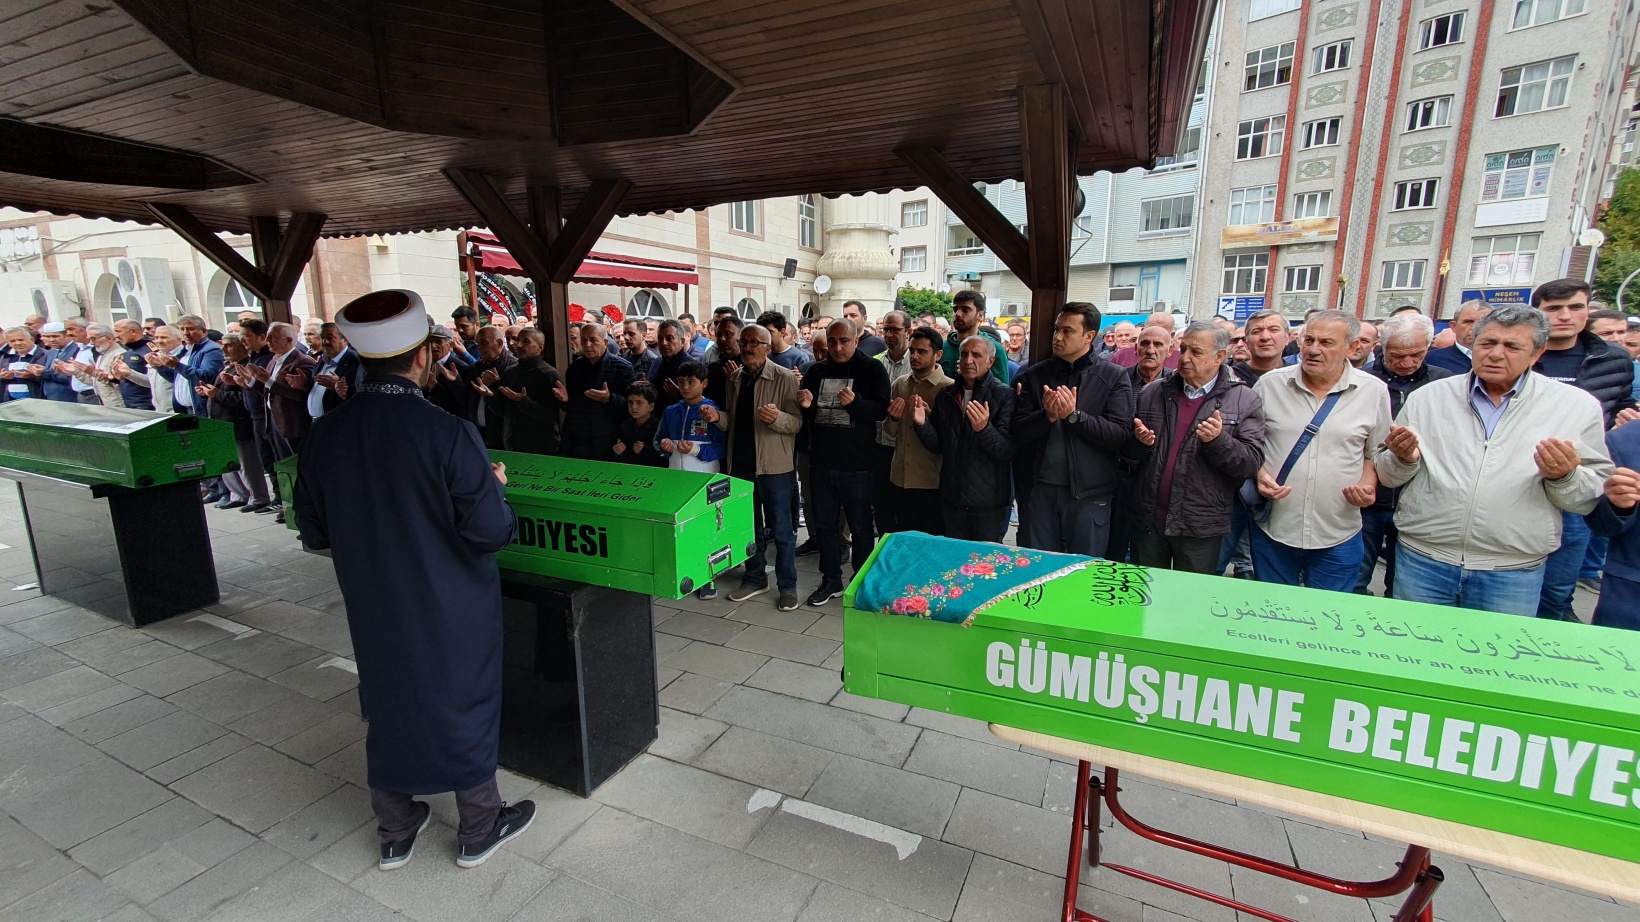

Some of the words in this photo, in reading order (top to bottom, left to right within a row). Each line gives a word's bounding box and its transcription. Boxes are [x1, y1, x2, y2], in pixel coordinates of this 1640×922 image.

[561, 487, 587, 496] Saat
[610, 492, 642, 503] Gider
[986, 638, 1305, 743] GÜMÜŞHANE
[1226, 629, 1291, 646] Ecelleri
[1295, 640, 1362, 656] gelince
[1367, 651, 1391, 661] ne
[1395, 654, 1423, 666] bir
[1429, 660, 1454, 671] an
[1459, 665, 1500, 677] geri
[1504, 670, 1580, 690] kalırlar
[1587, 683, 1616, 696] ne
